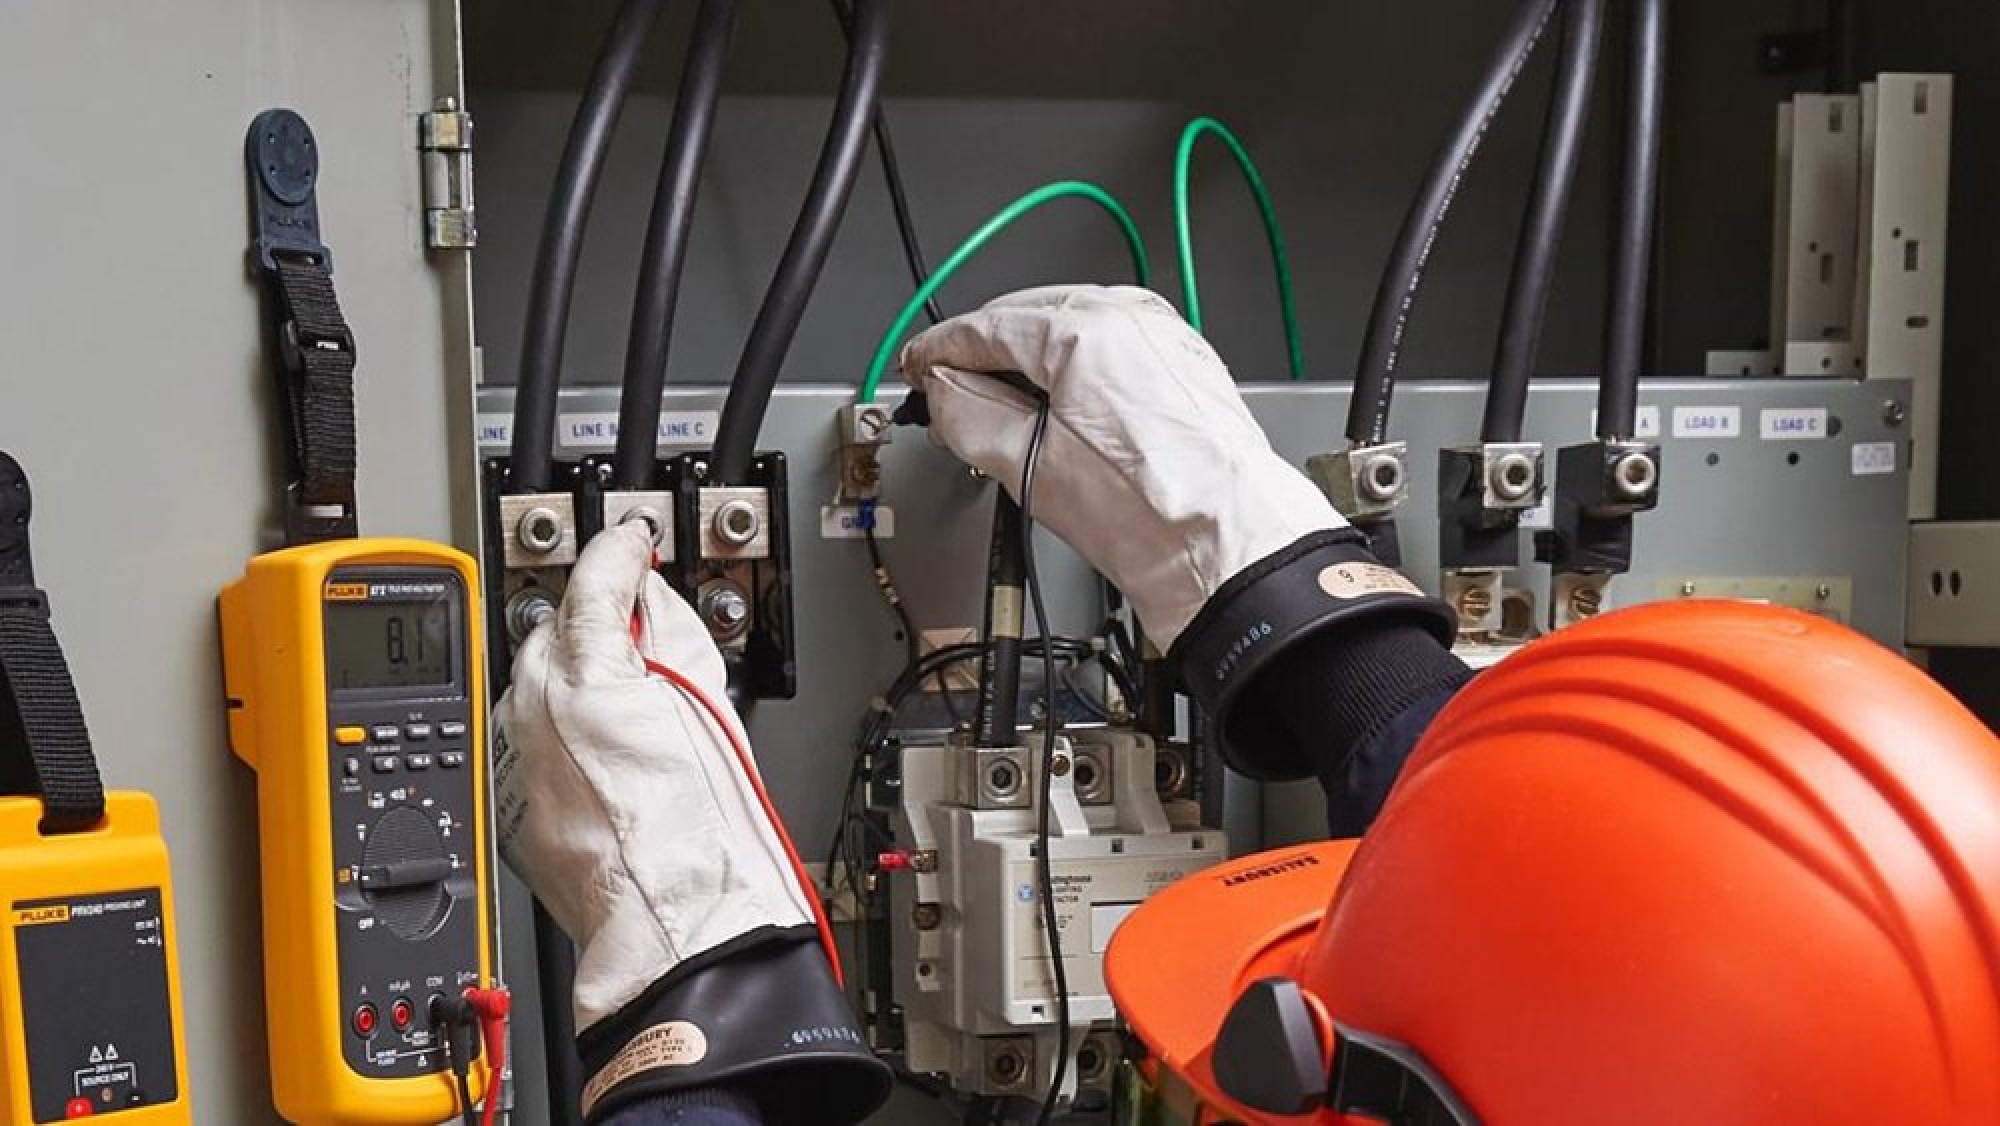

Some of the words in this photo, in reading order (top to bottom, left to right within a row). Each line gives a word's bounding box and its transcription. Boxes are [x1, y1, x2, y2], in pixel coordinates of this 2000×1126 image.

[572, 422, 603, 438] LINE
[694, 421, 705, 436] C
[1771, 417, 1805, 432] LOAD
